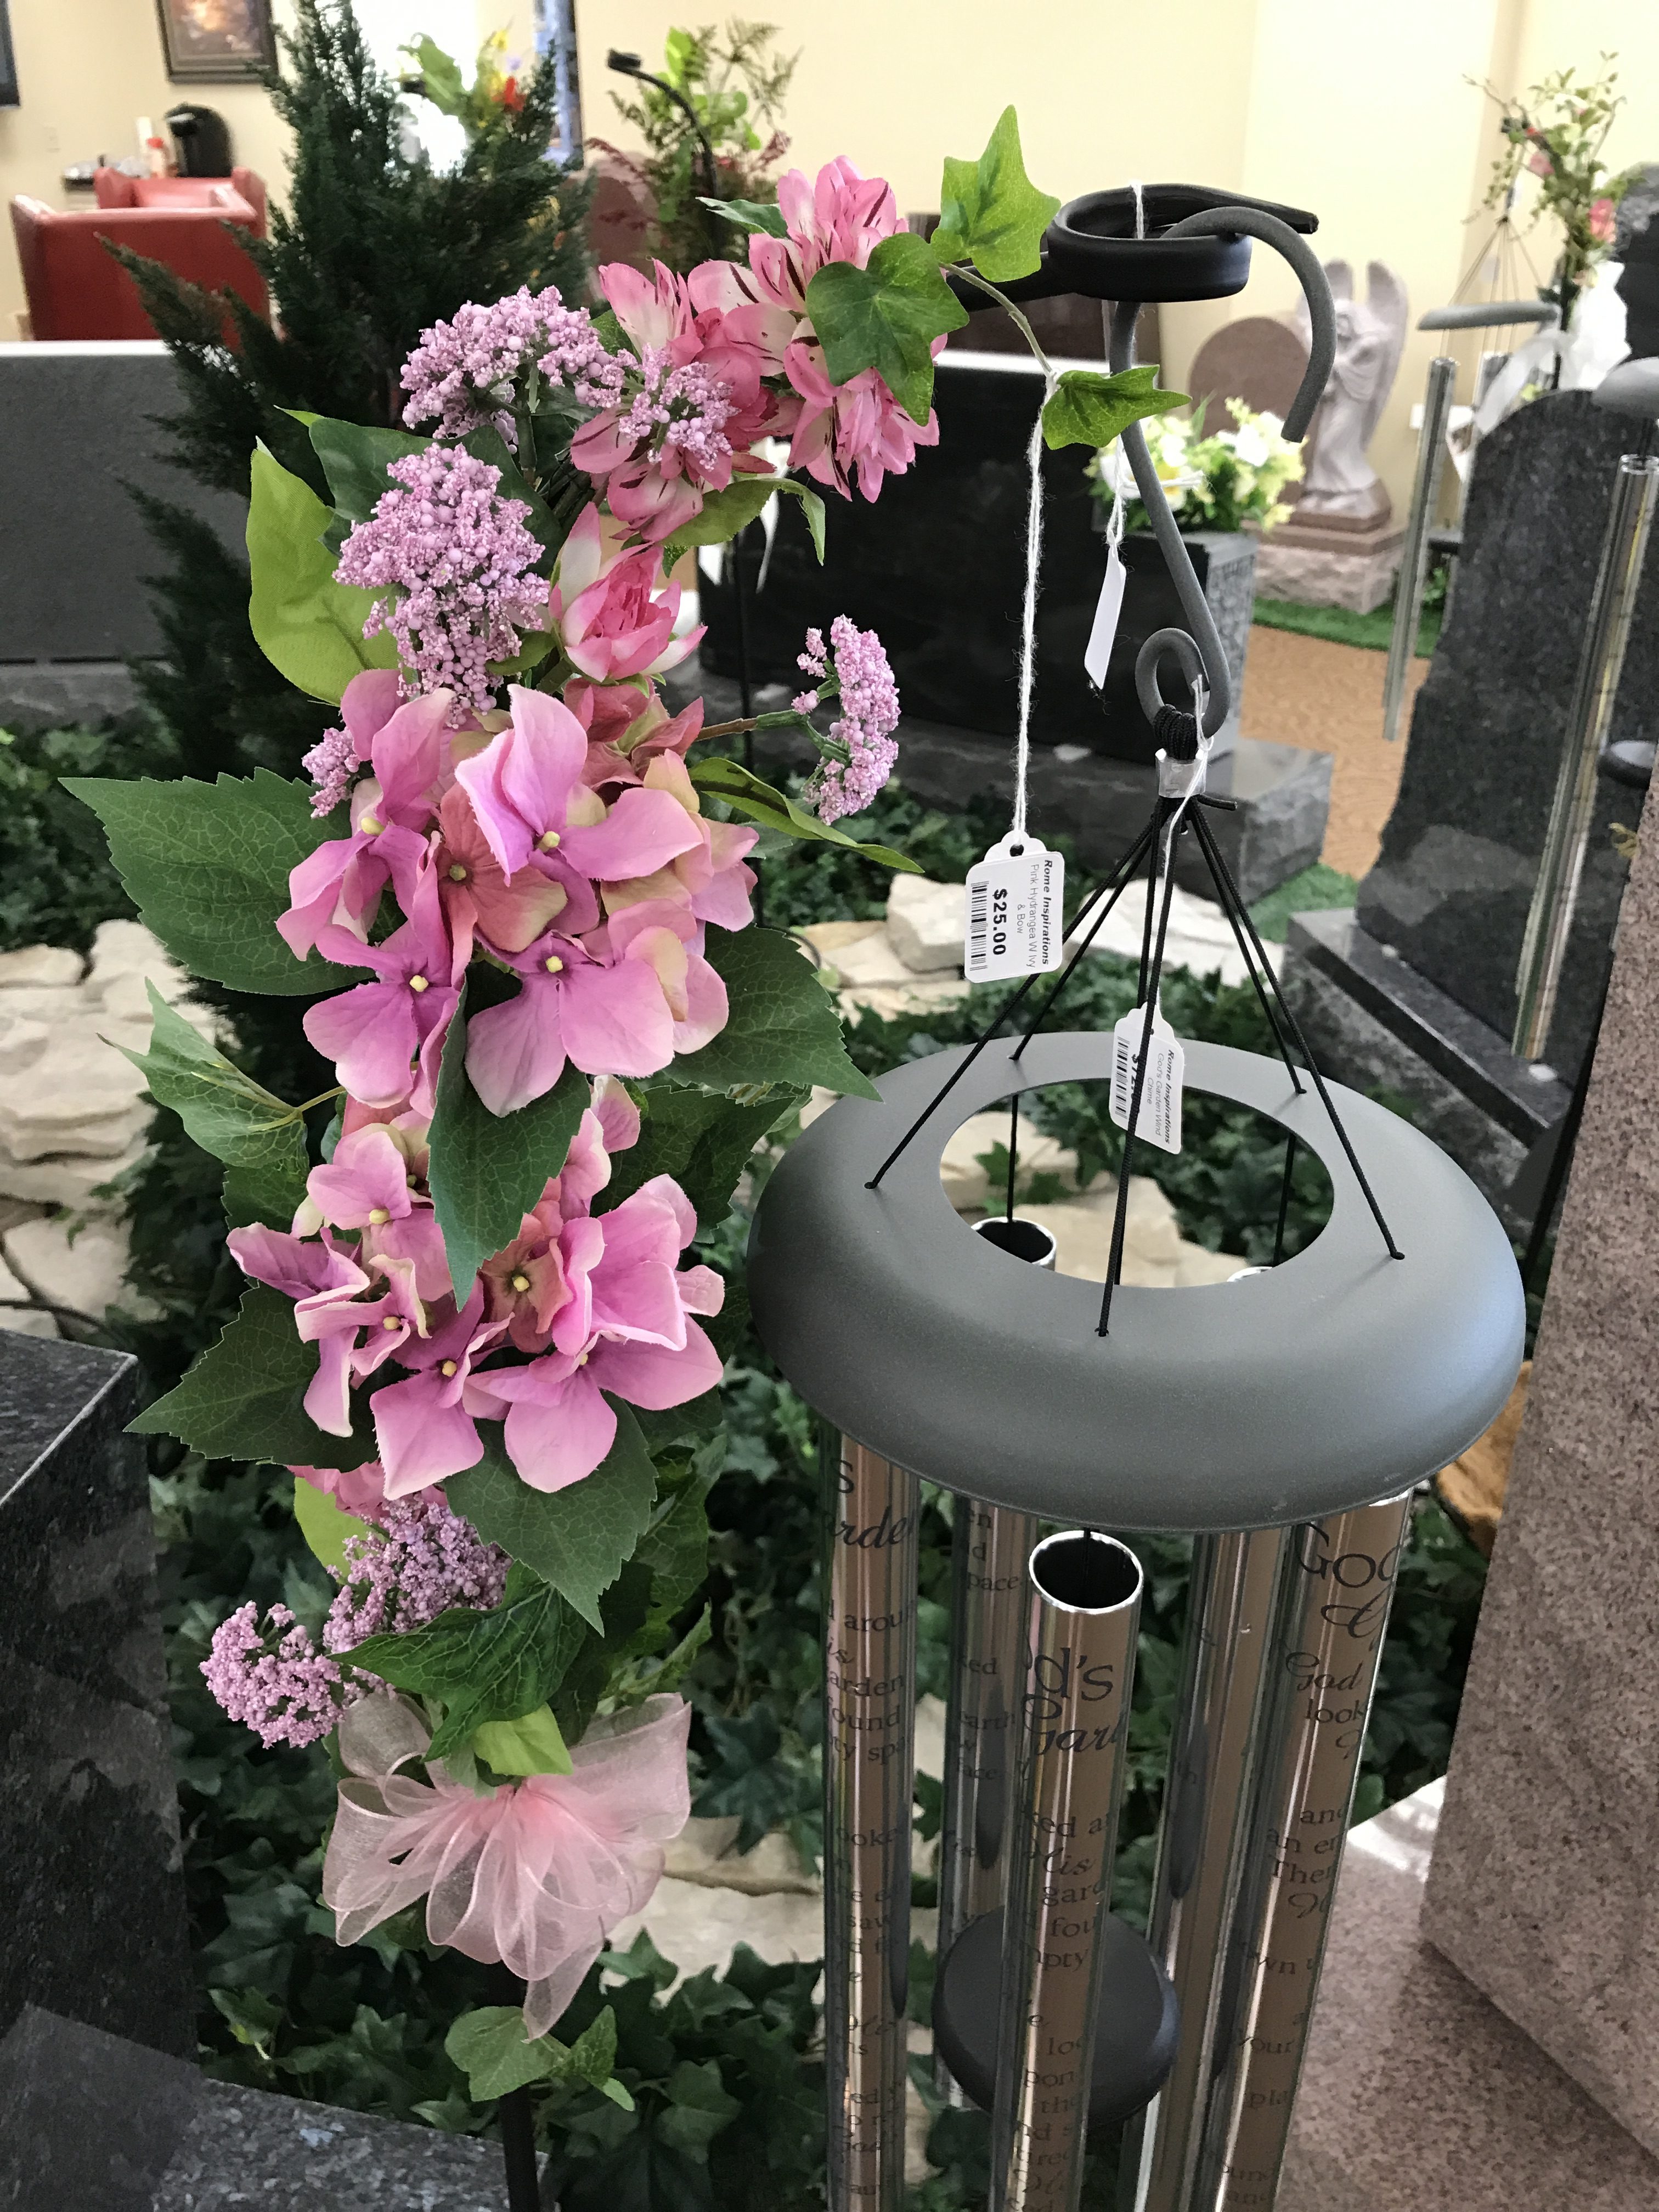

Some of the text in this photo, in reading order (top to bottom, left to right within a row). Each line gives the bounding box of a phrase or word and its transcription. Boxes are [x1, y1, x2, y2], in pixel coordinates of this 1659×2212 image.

[1030, 864, 1040, 885] Pink
[992, 888, 1008, 955] $25.00
[1017, 913, 1025, 934] Bow
[1027, 888, 1039, 939] Hydrangea
[1041, 860, 1053, 965] Rome Inspirations
[1026, 955, 1037, 968] Ivy
[1164, 1049, 1174, 1144] Rome Inspirations
[968, 1573, 1019, 1592] pace
[830, 1671, 904, 1697] arden
[831, 1704, 901, 1732] ound
[1305, 1699, 1363, 1724] look
